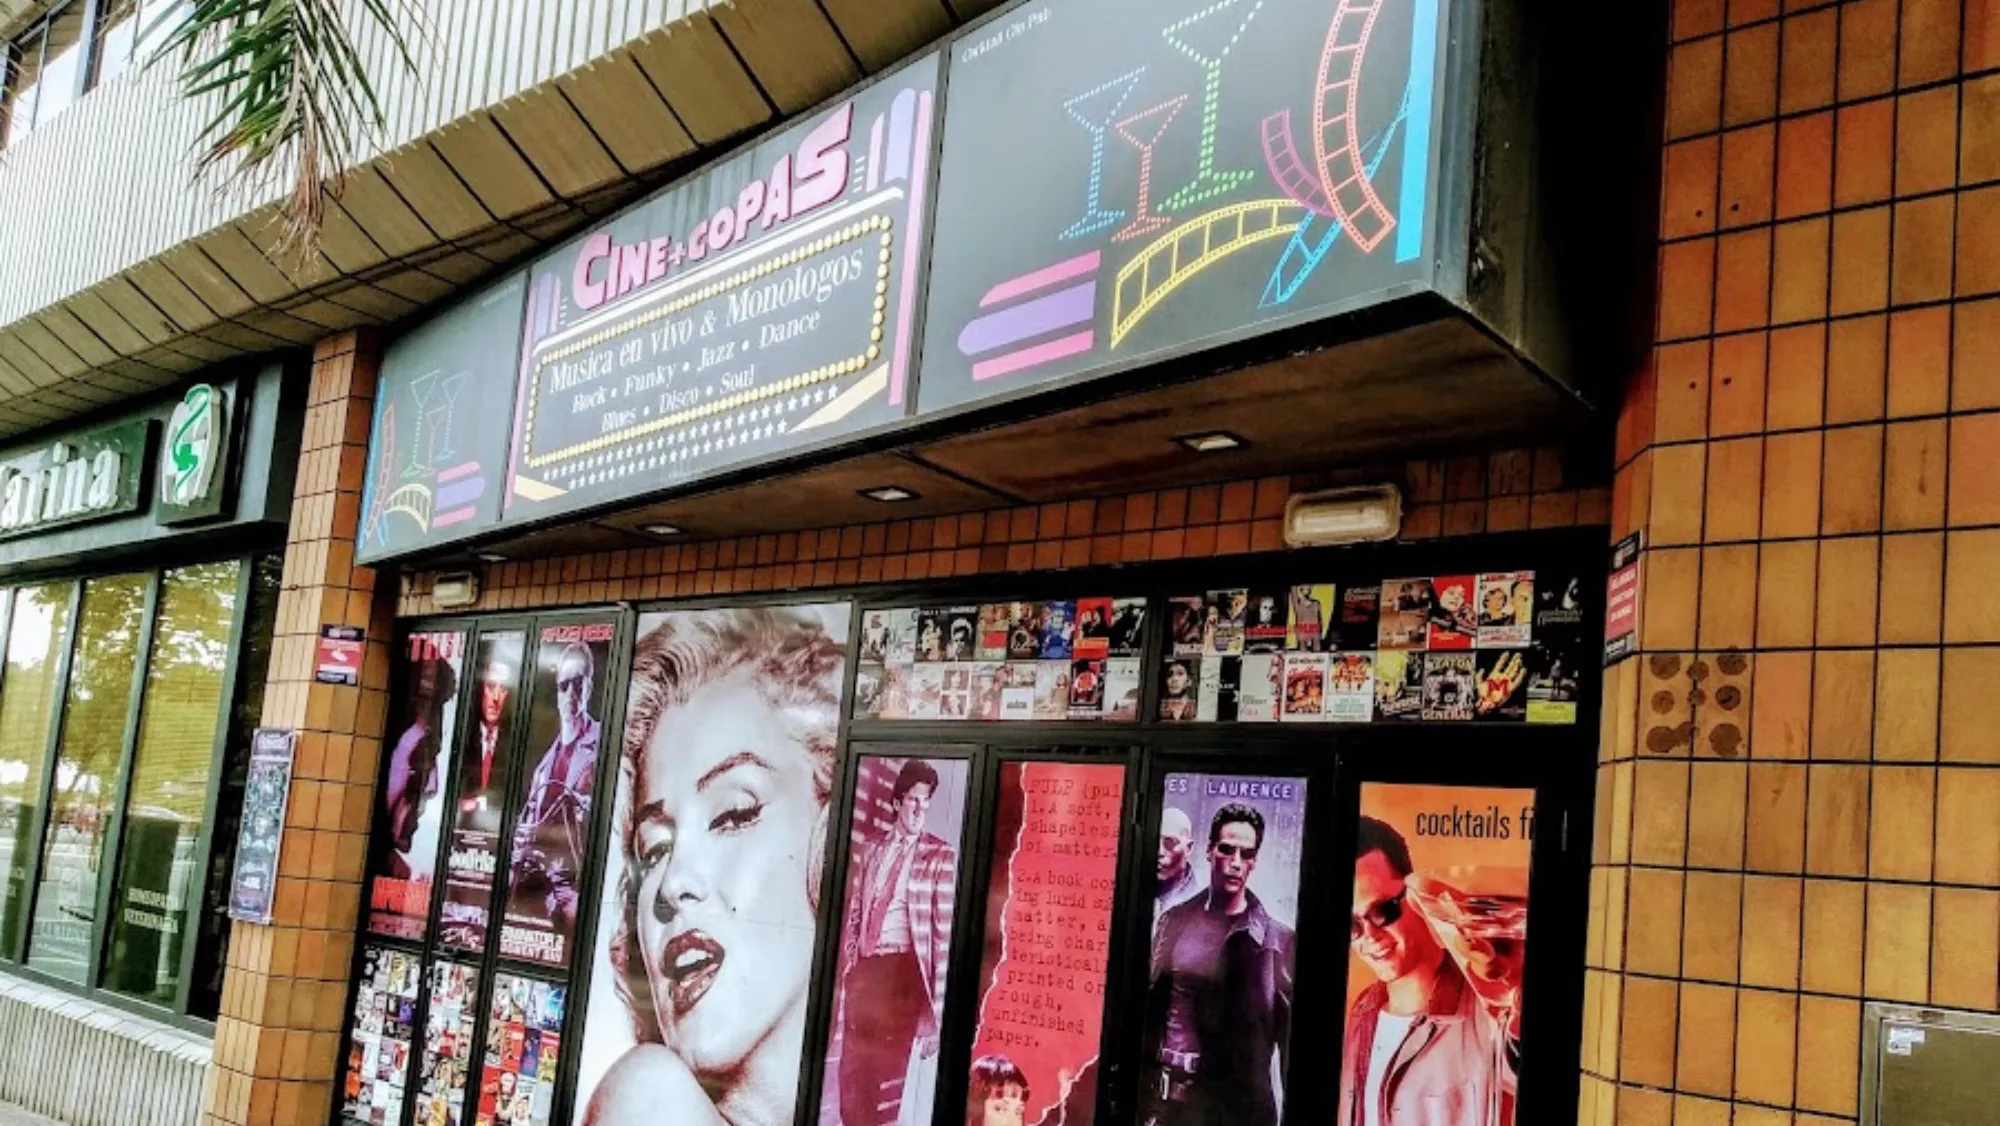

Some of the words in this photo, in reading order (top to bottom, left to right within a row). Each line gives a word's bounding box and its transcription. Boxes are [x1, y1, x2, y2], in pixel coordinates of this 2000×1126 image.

[548, 349, 614, 394] Musica
[618, 338, 644, 366] en
[649, 315, 695, 356] vivo
[699, 309, 717, 334] &
[726, 247, 866, 329] Monologos
[571, 388, 609, 415] Rock
[623, 357, 678, 398] Funky
[696, 338, 736, 373] Jazz
[759, 310, 821, 350] Dance
[600, 406, 638, 433] Blues
[658, 386, 700, 413] Disco
[719, 364, 756, 393] Soul
[0, 441, 122, 530] arina
[1028, 779, 1075, 796] PULP
[1207, 779, 1292, 799] LAURENCE
[1067, 801, 1111, 820] soft,
[1416, 804, 1511, 840] cocktails
[1047, 870, 1083, 887] book
[1046, 890, 1087, 909] lurid
[1010, 926, 1055, 949] being
[1063, 935, 1107, 952] char
[1006, 968, 1075, 991] printed
[998, 988, 1063, 1012] rough,
[991, 1007, 1086, 1036] unfinished
[985, 1027, 1041, 1048] paper.
